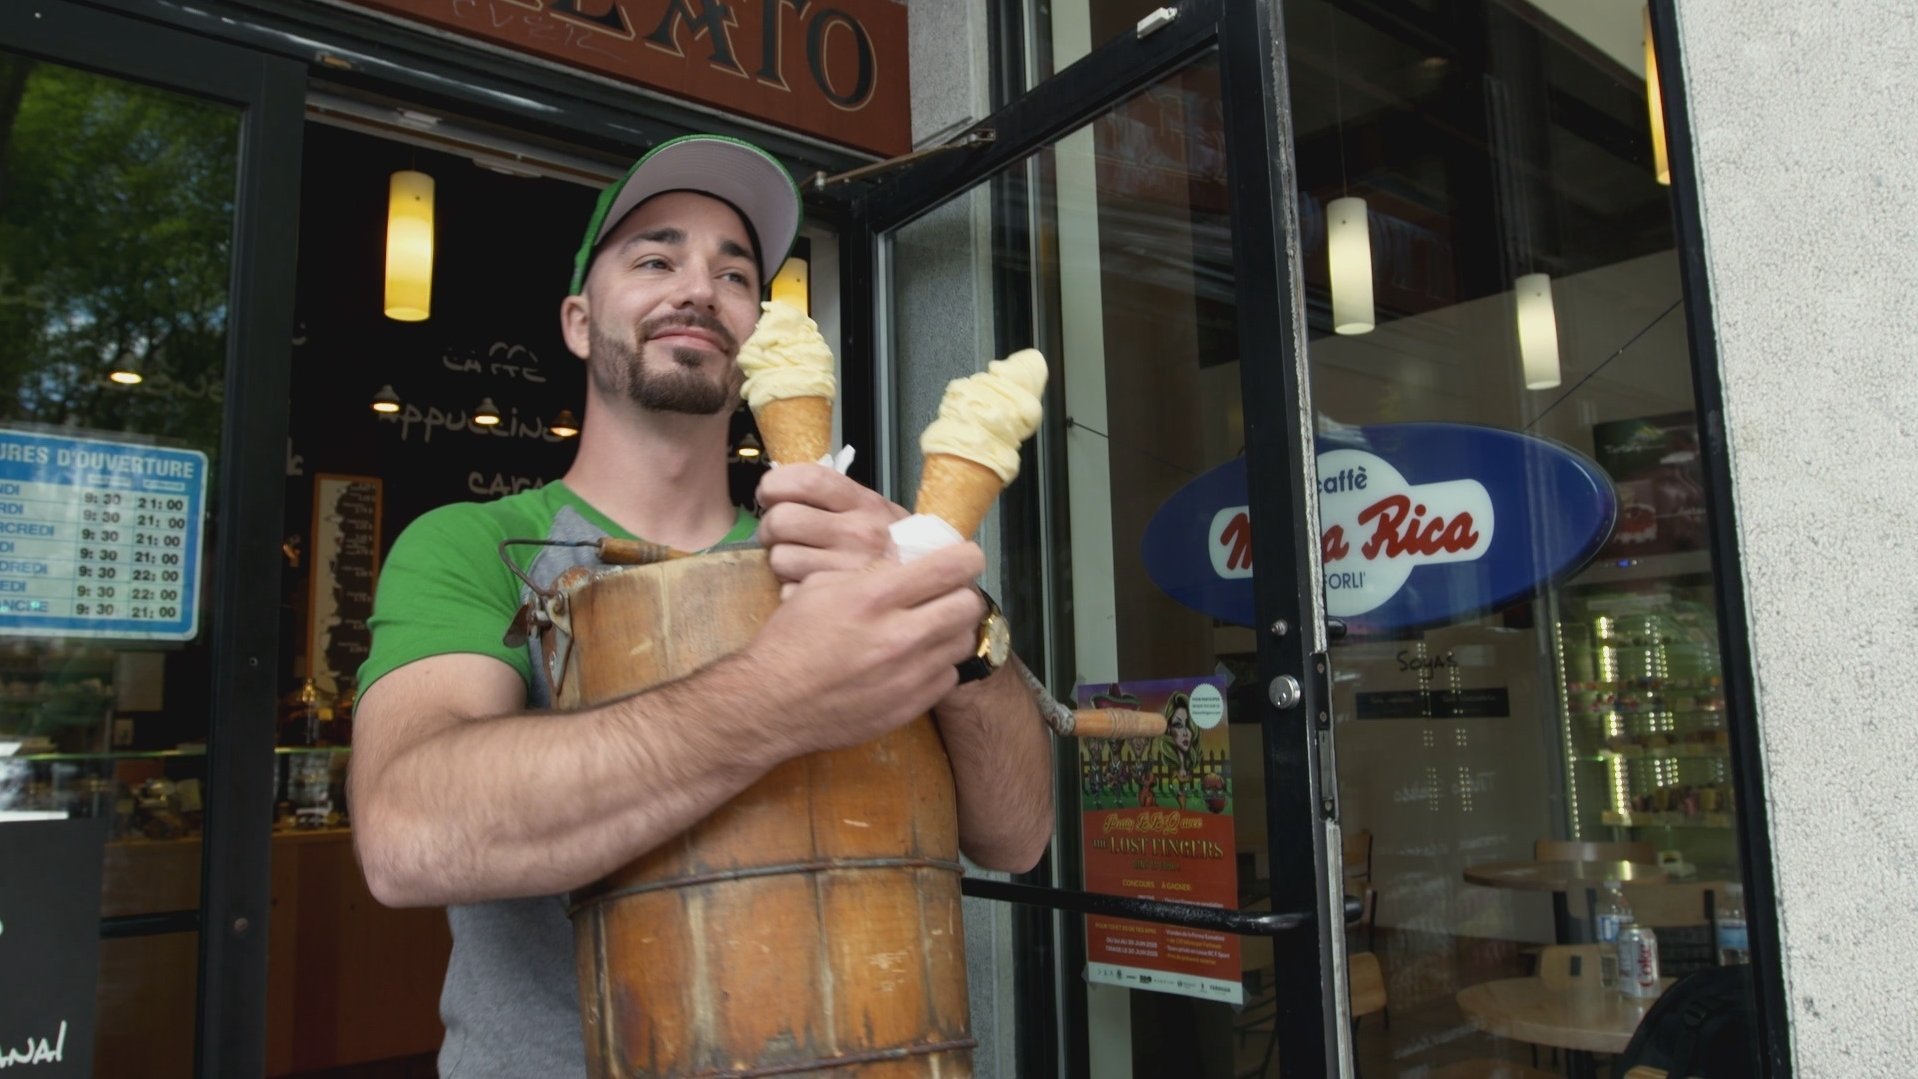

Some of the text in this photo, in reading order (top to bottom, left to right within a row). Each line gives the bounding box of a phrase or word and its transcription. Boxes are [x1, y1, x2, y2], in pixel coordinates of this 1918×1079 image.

[57, 448, 194, 479] D'OUVERTURE
[1357, 494, 1480, 561] Rica
[1324, 571, 1367, 590] ORLI'
[0, 600, 49, 613] NCHE
[1110, 836, 1149, 854] LOST
[1151, 837, 1225, 860] FINGERS
